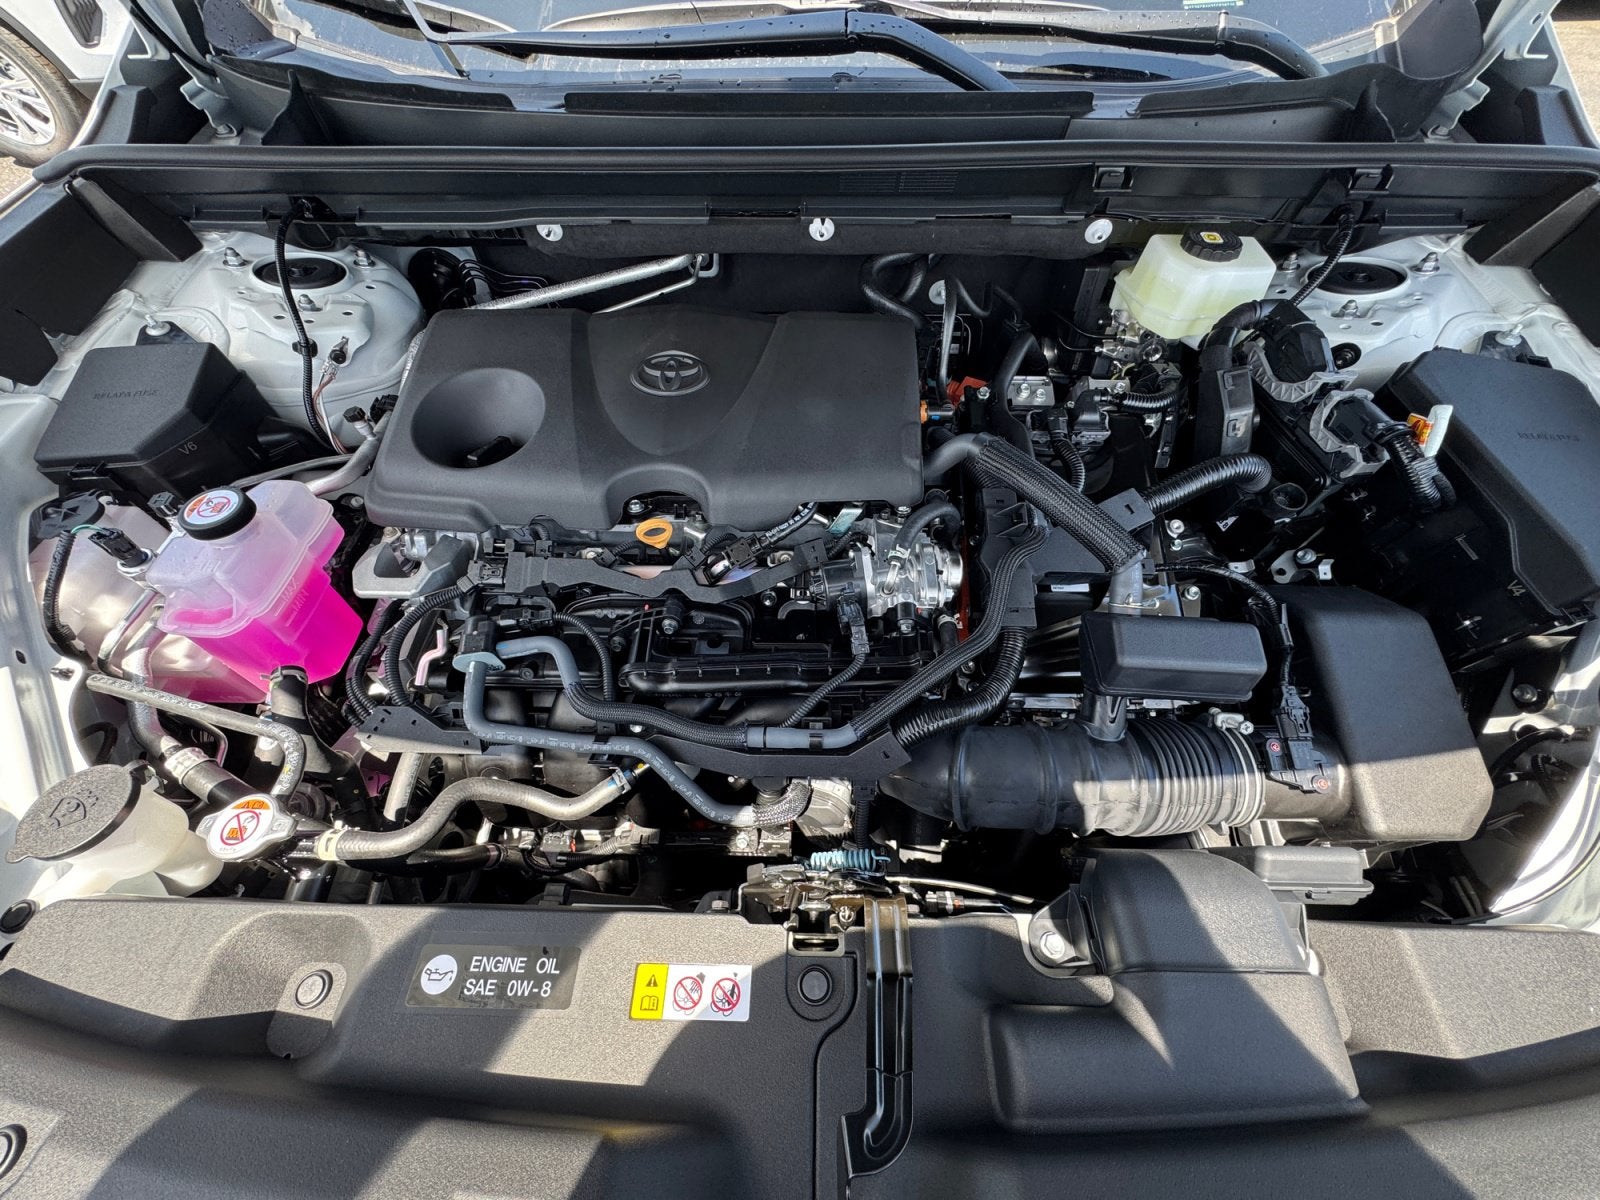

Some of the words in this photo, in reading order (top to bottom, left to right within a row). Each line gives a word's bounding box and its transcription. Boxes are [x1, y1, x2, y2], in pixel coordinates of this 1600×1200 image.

[178, 441, 198, 455] V6
[1507, 579, 1526, 597] V4
[469, 956, 527, 973] ENGINE
[536, 957, 561, 974] OIL
[463, 978, 497, 996] SAE
[507, 980, 552, 998] 0W-8
